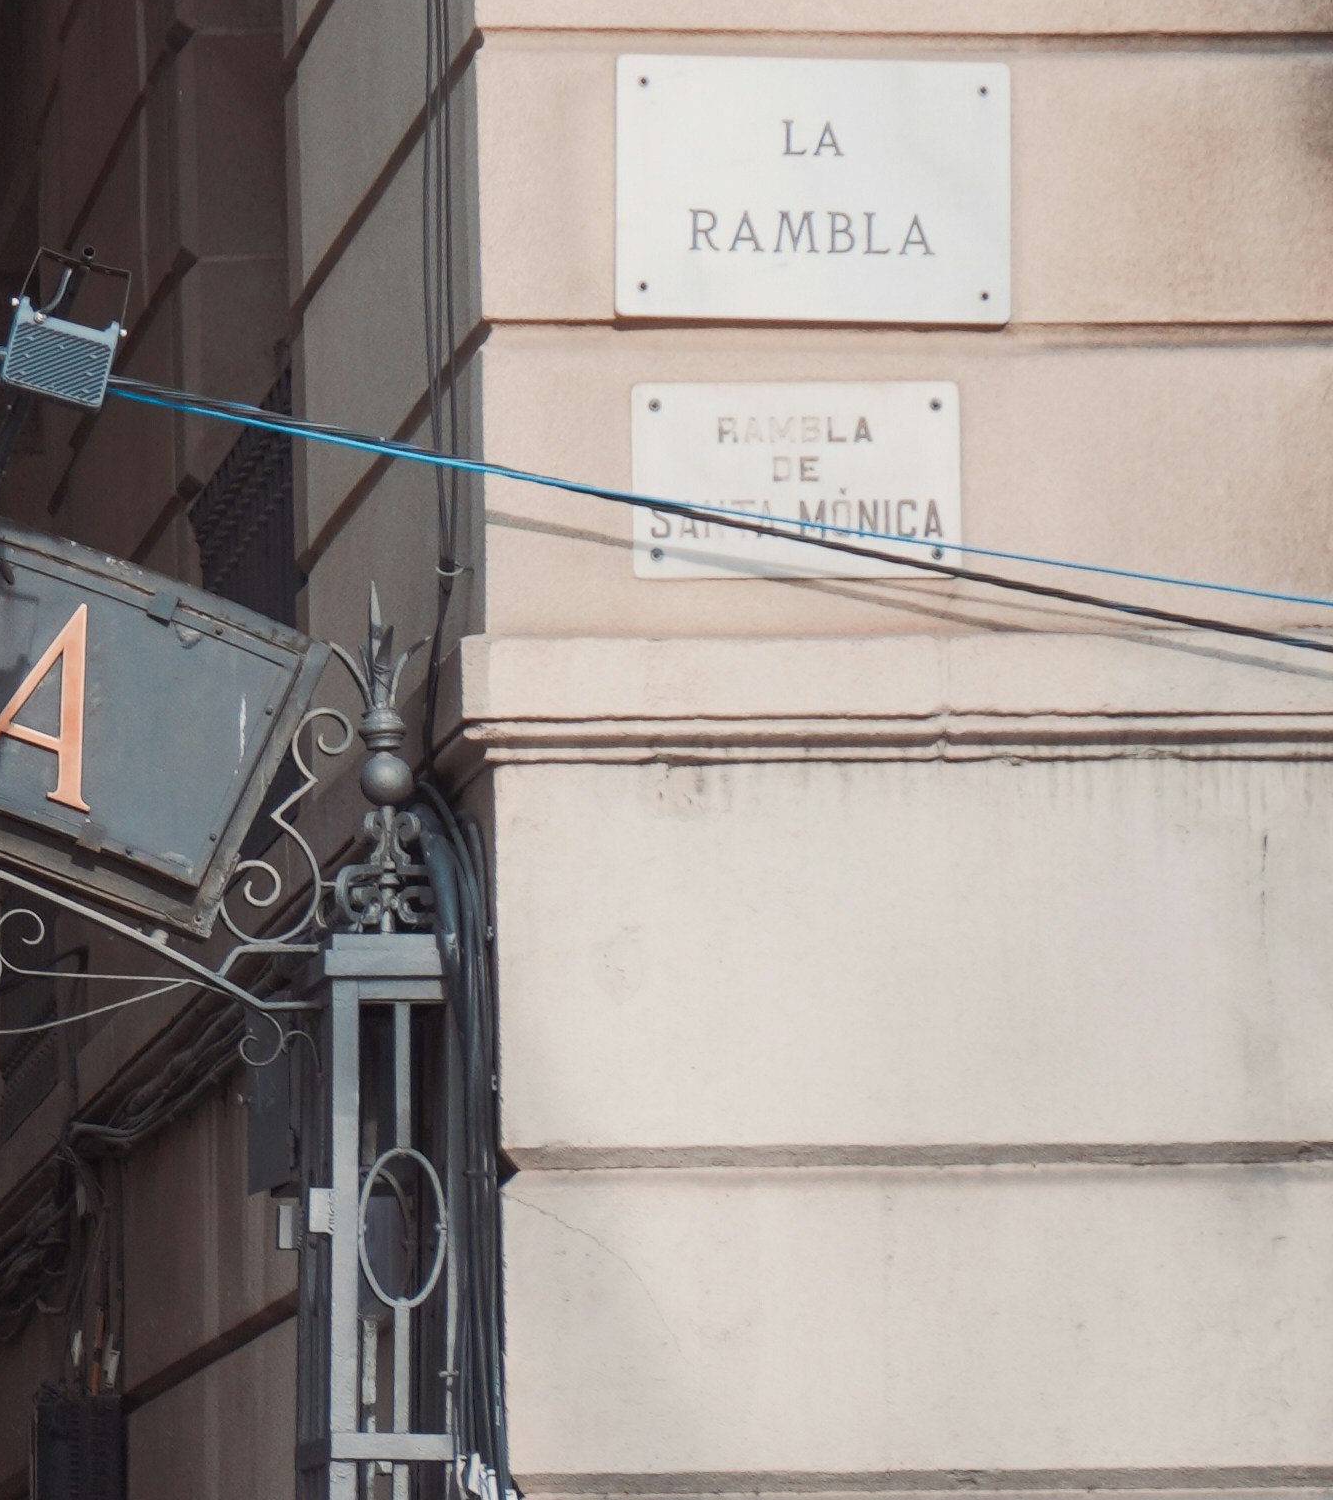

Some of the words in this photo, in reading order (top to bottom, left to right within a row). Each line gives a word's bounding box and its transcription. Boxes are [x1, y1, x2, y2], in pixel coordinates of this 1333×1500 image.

[781, 119, 845, 157] LA
[687, 208, 936, 257] RAMBLA
[715, 415, 875, 444] RAMBLA
[771, 455, 821, 483] DE
